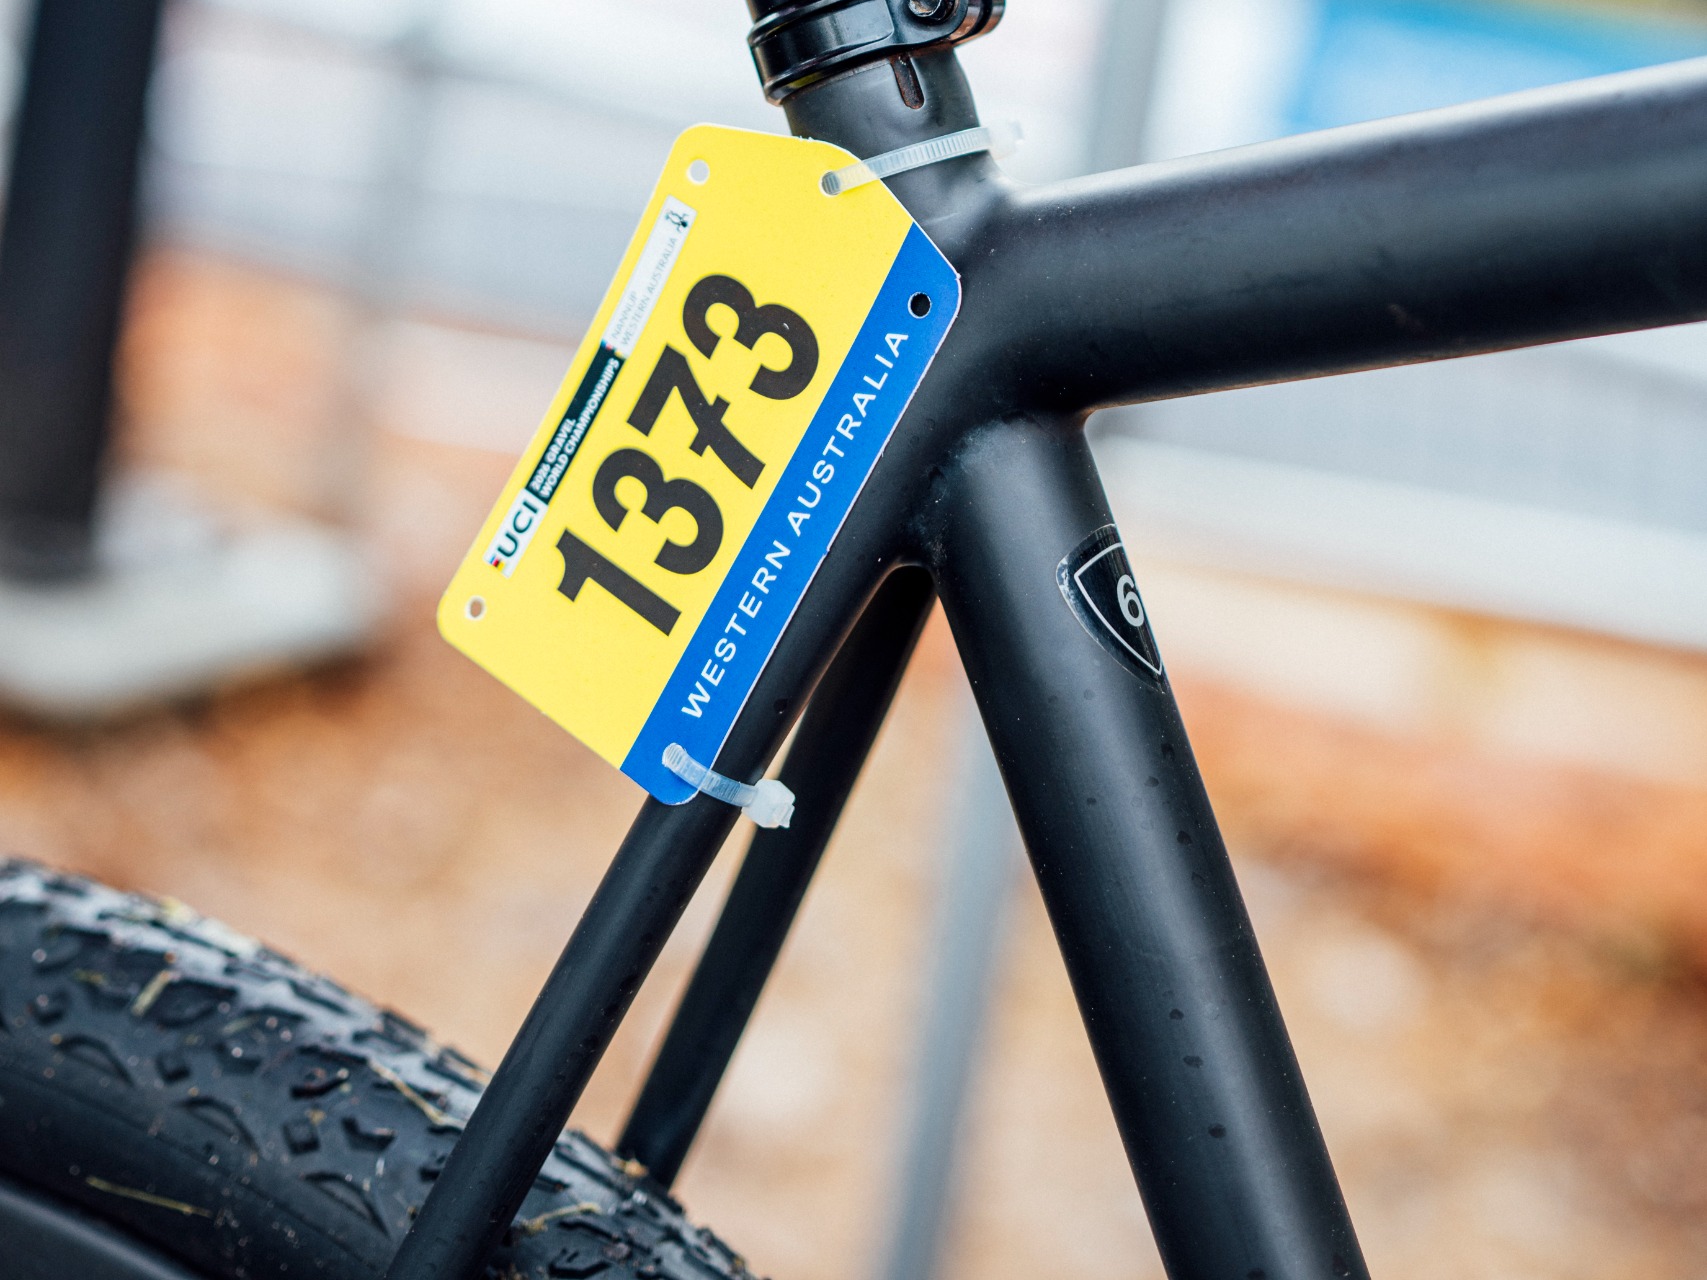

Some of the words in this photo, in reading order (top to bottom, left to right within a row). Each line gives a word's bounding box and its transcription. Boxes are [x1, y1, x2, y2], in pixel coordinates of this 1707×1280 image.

[611, 291, 638, 340] NANNUP
[621, 296, 651, 345] WESTERN
[647, 237, 677, 295] AUSTRALIA
[529, 462, 551, 493] 2026
[545, 418, 576, 465] GRAVEL
[539, 453, 569, 499] WORLD
[564, 357, 620, 456] CHAMPIONSHIPS
[556, 275, 820, 637] 1373
[497, 500, 539, 558] UCI
[681, 540, 791, 718] WESTERN
[787, 330, 909, 537] AUSTRALIA
